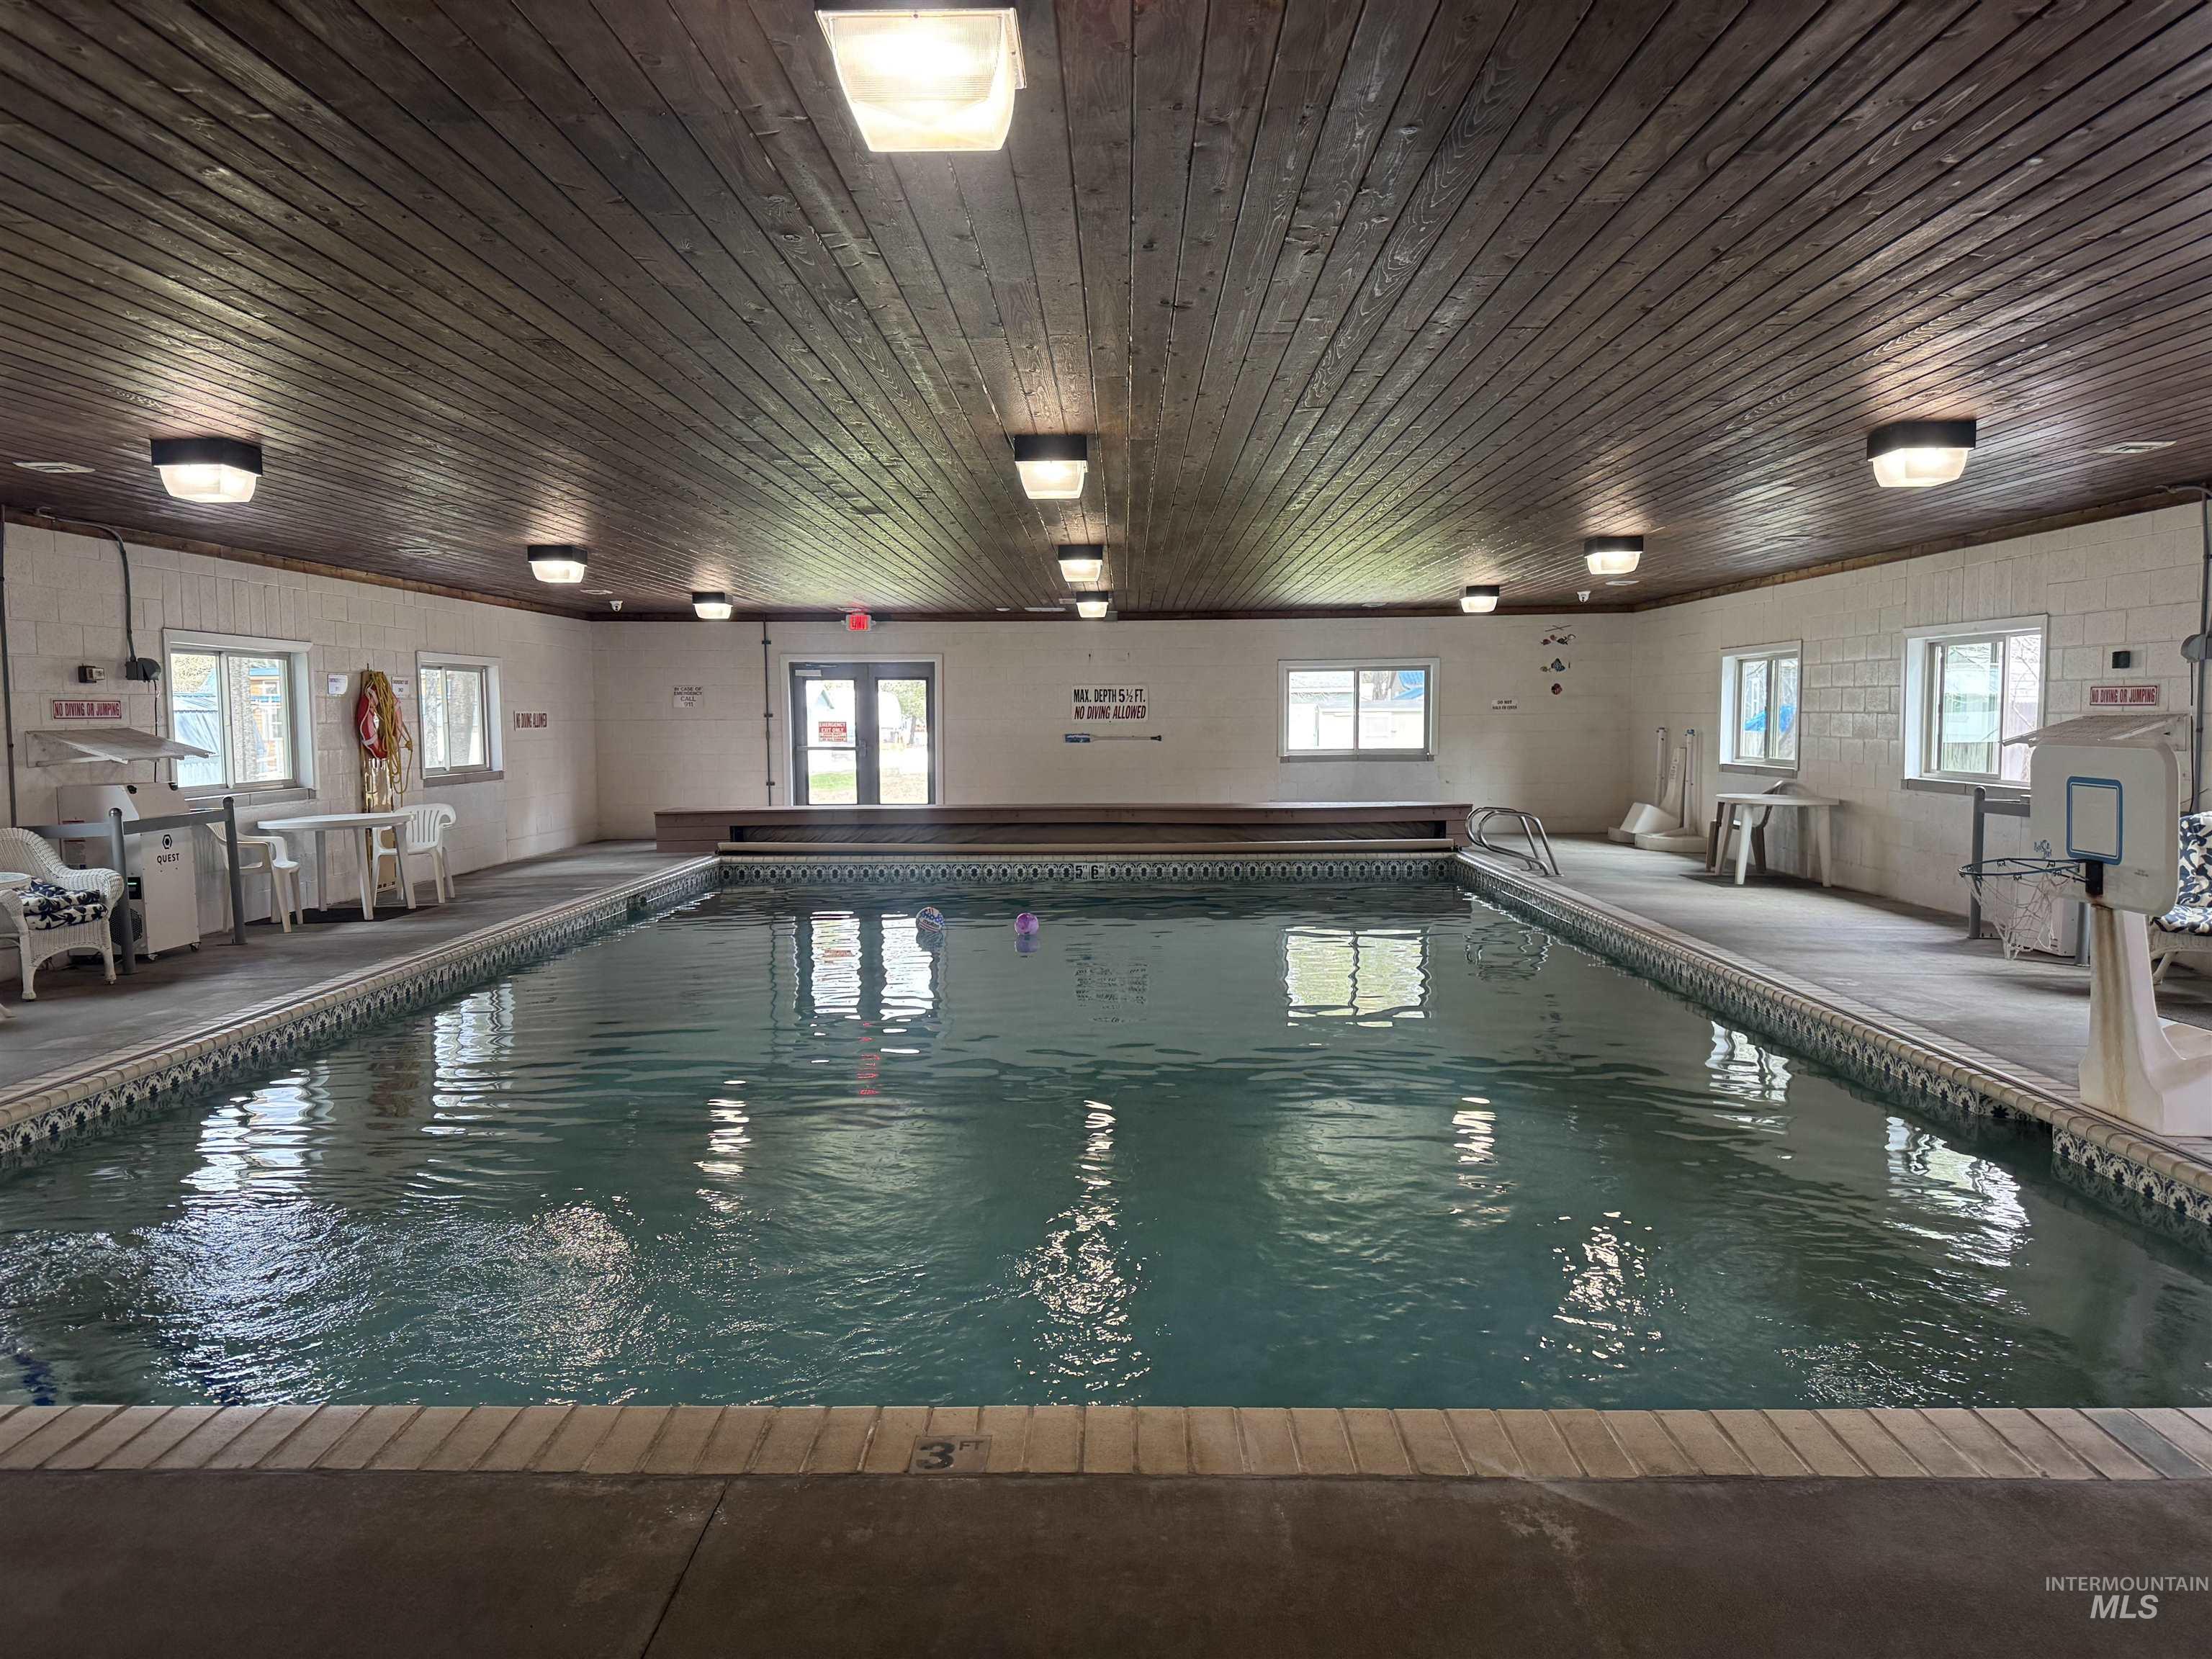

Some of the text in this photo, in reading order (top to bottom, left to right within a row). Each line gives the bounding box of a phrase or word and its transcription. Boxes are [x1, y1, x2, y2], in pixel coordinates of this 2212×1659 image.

[1074, 689, 1092, 703] MAX.
[1094, 689, 1117, 703] DEPTH
[1135, 689, 1146, 703] FT.
[2091, 688, 2155, 703] NO DIVING OR JUMPING
[55, 703, 120, 716] NO DIVING OR JUMPING
[1074, 705, 1146, 719] NO DIVING ALLOWED
[516, 713, 547, 728] NO DIVING ALLOWED
[156, 853, 179, 865] QUEST
